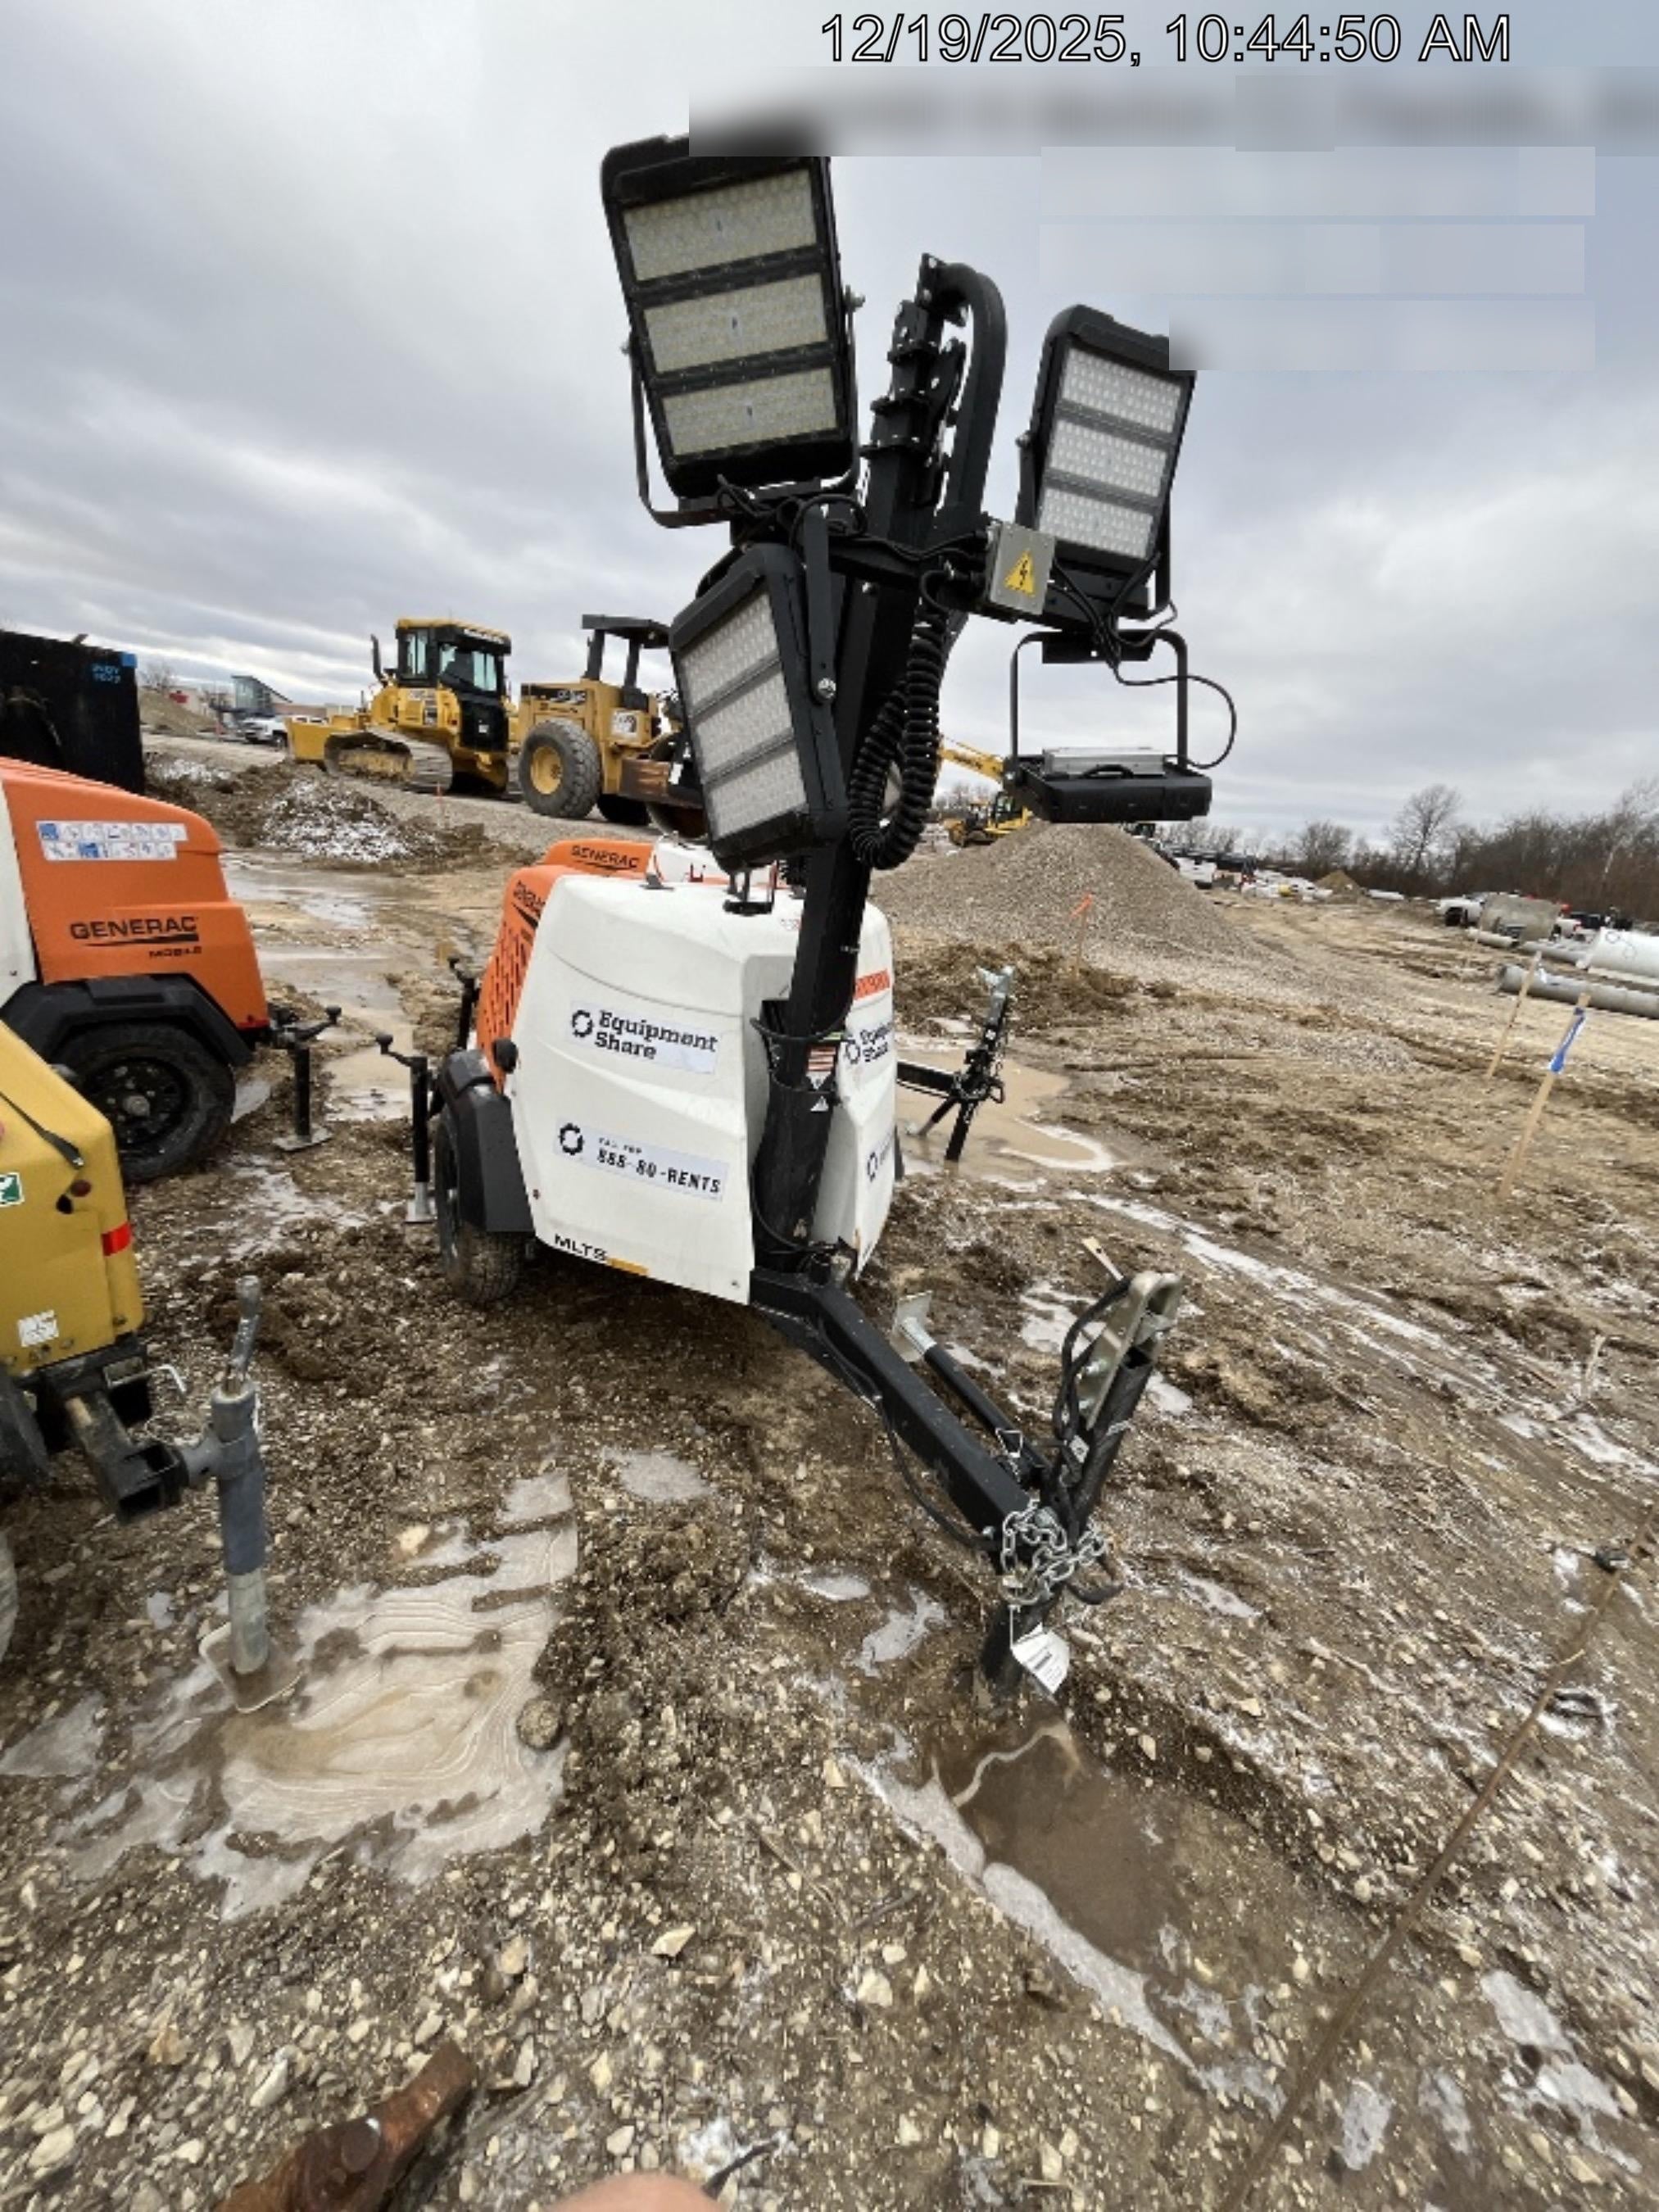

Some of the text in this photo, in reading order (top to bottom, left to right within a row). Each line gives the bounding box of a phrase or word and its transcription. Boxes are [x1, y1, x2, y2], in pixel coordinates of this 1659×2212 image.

[571, 845, 641, 868] GENERAC
[70, 916, 197, 940] GENERAC
[599, 1009, 718, 1052] Equipment
[595, 1031, 657, 1059] Share
